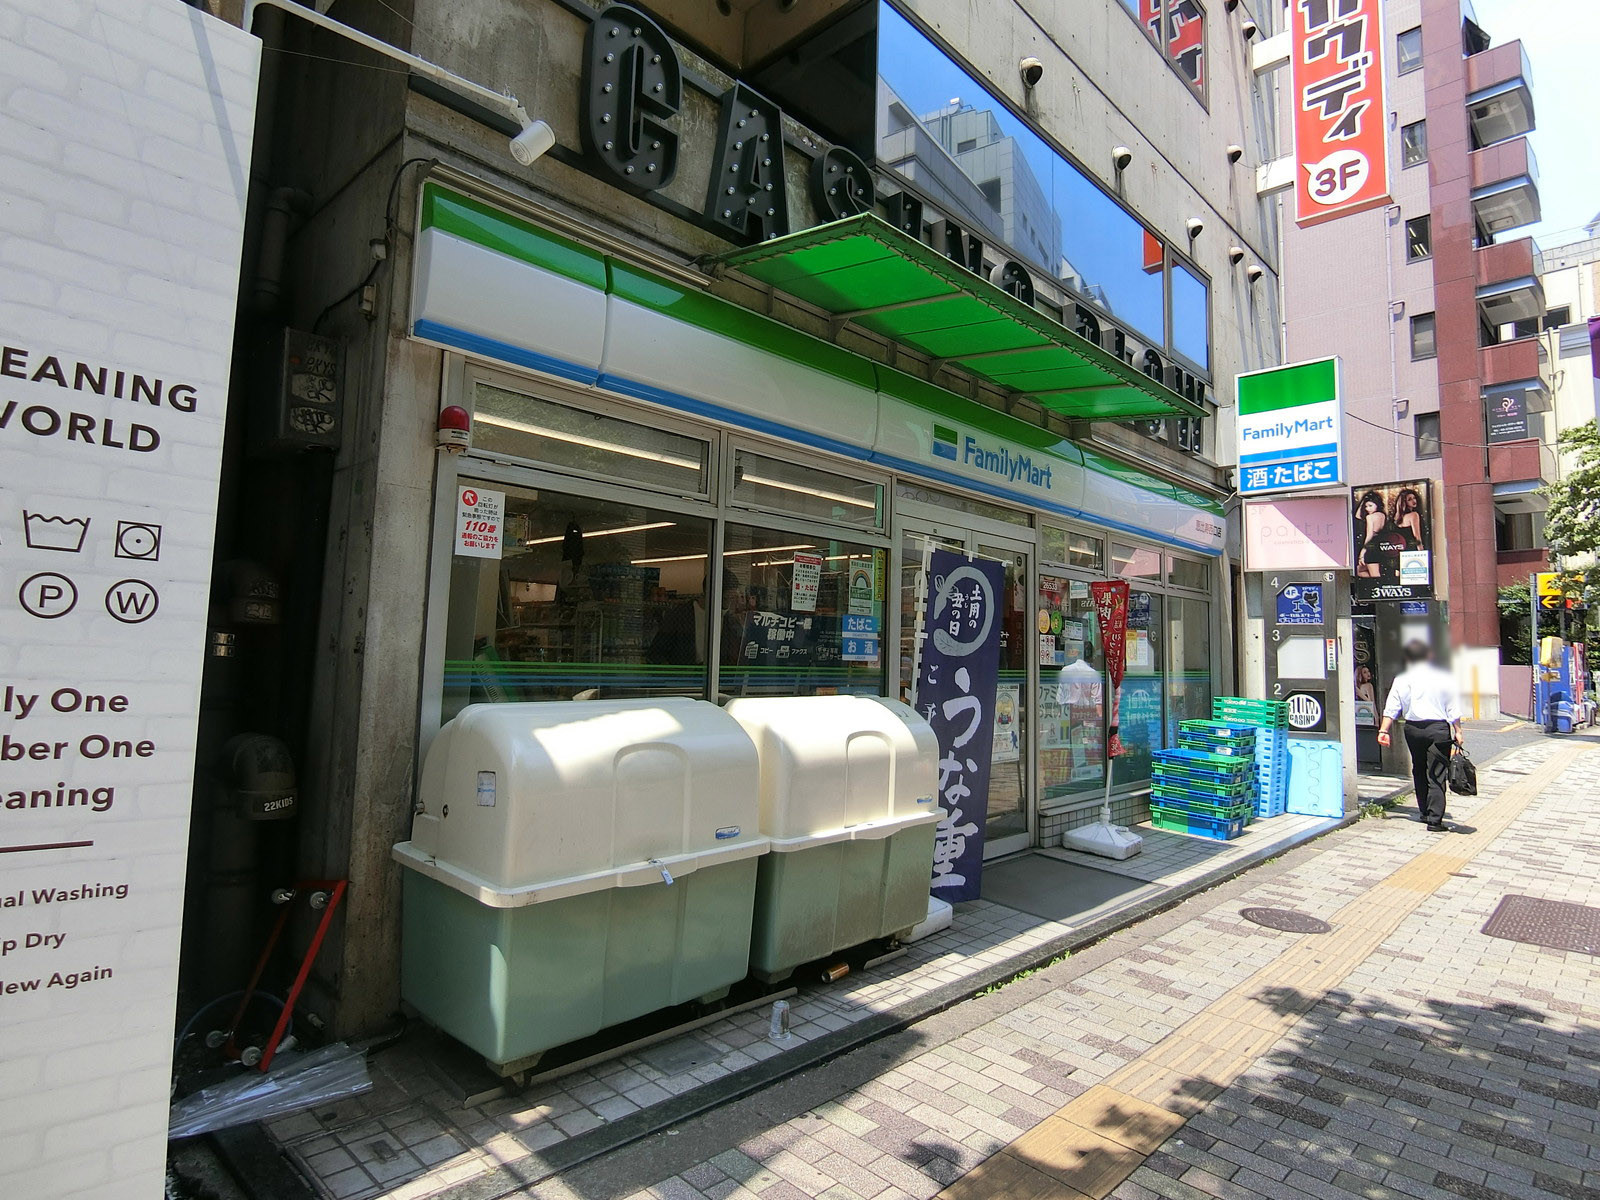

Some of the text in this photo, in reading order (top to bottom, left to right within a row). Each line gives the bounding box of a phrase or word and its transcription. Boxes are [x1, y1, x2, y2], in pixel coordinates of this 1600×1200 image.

[1315, 159, 1361, 197] 3F
[1, 346, 198, 413] EANING
[1242, 416, 1333, 441] FamilyMart
[964, 436, 1053, 490] FamilyMart
[1246, 461, 1332, 488] 酒・たばこ
[465, 520, 497, 533] 110番
[1379, 543, 1404, 551] WAYS
[1270, 577, 1279, 588] 4
[1285, 589, 1297, 597] 4F
[949, 592, 965, 636] 丑の日
[970, 584, 983, 629] 土用の
[847, 617, 873, 631] たばこ
[1272, 630, 1281, 642] 3
[1273, 683, 1282, 695] 2
[4, 686, 129, 720] ly One
[1289, 714, 1316, 726] CASINO
[1, 734, 155, 761] ber One
[0, 781, 115, 812] aning
[264, 796, 294, 812] 22KIDS
[0, 882, 129, 908] al Washing
[25, 931, 67, 950] Dry
[0, 965, 113, 996] ew Again
